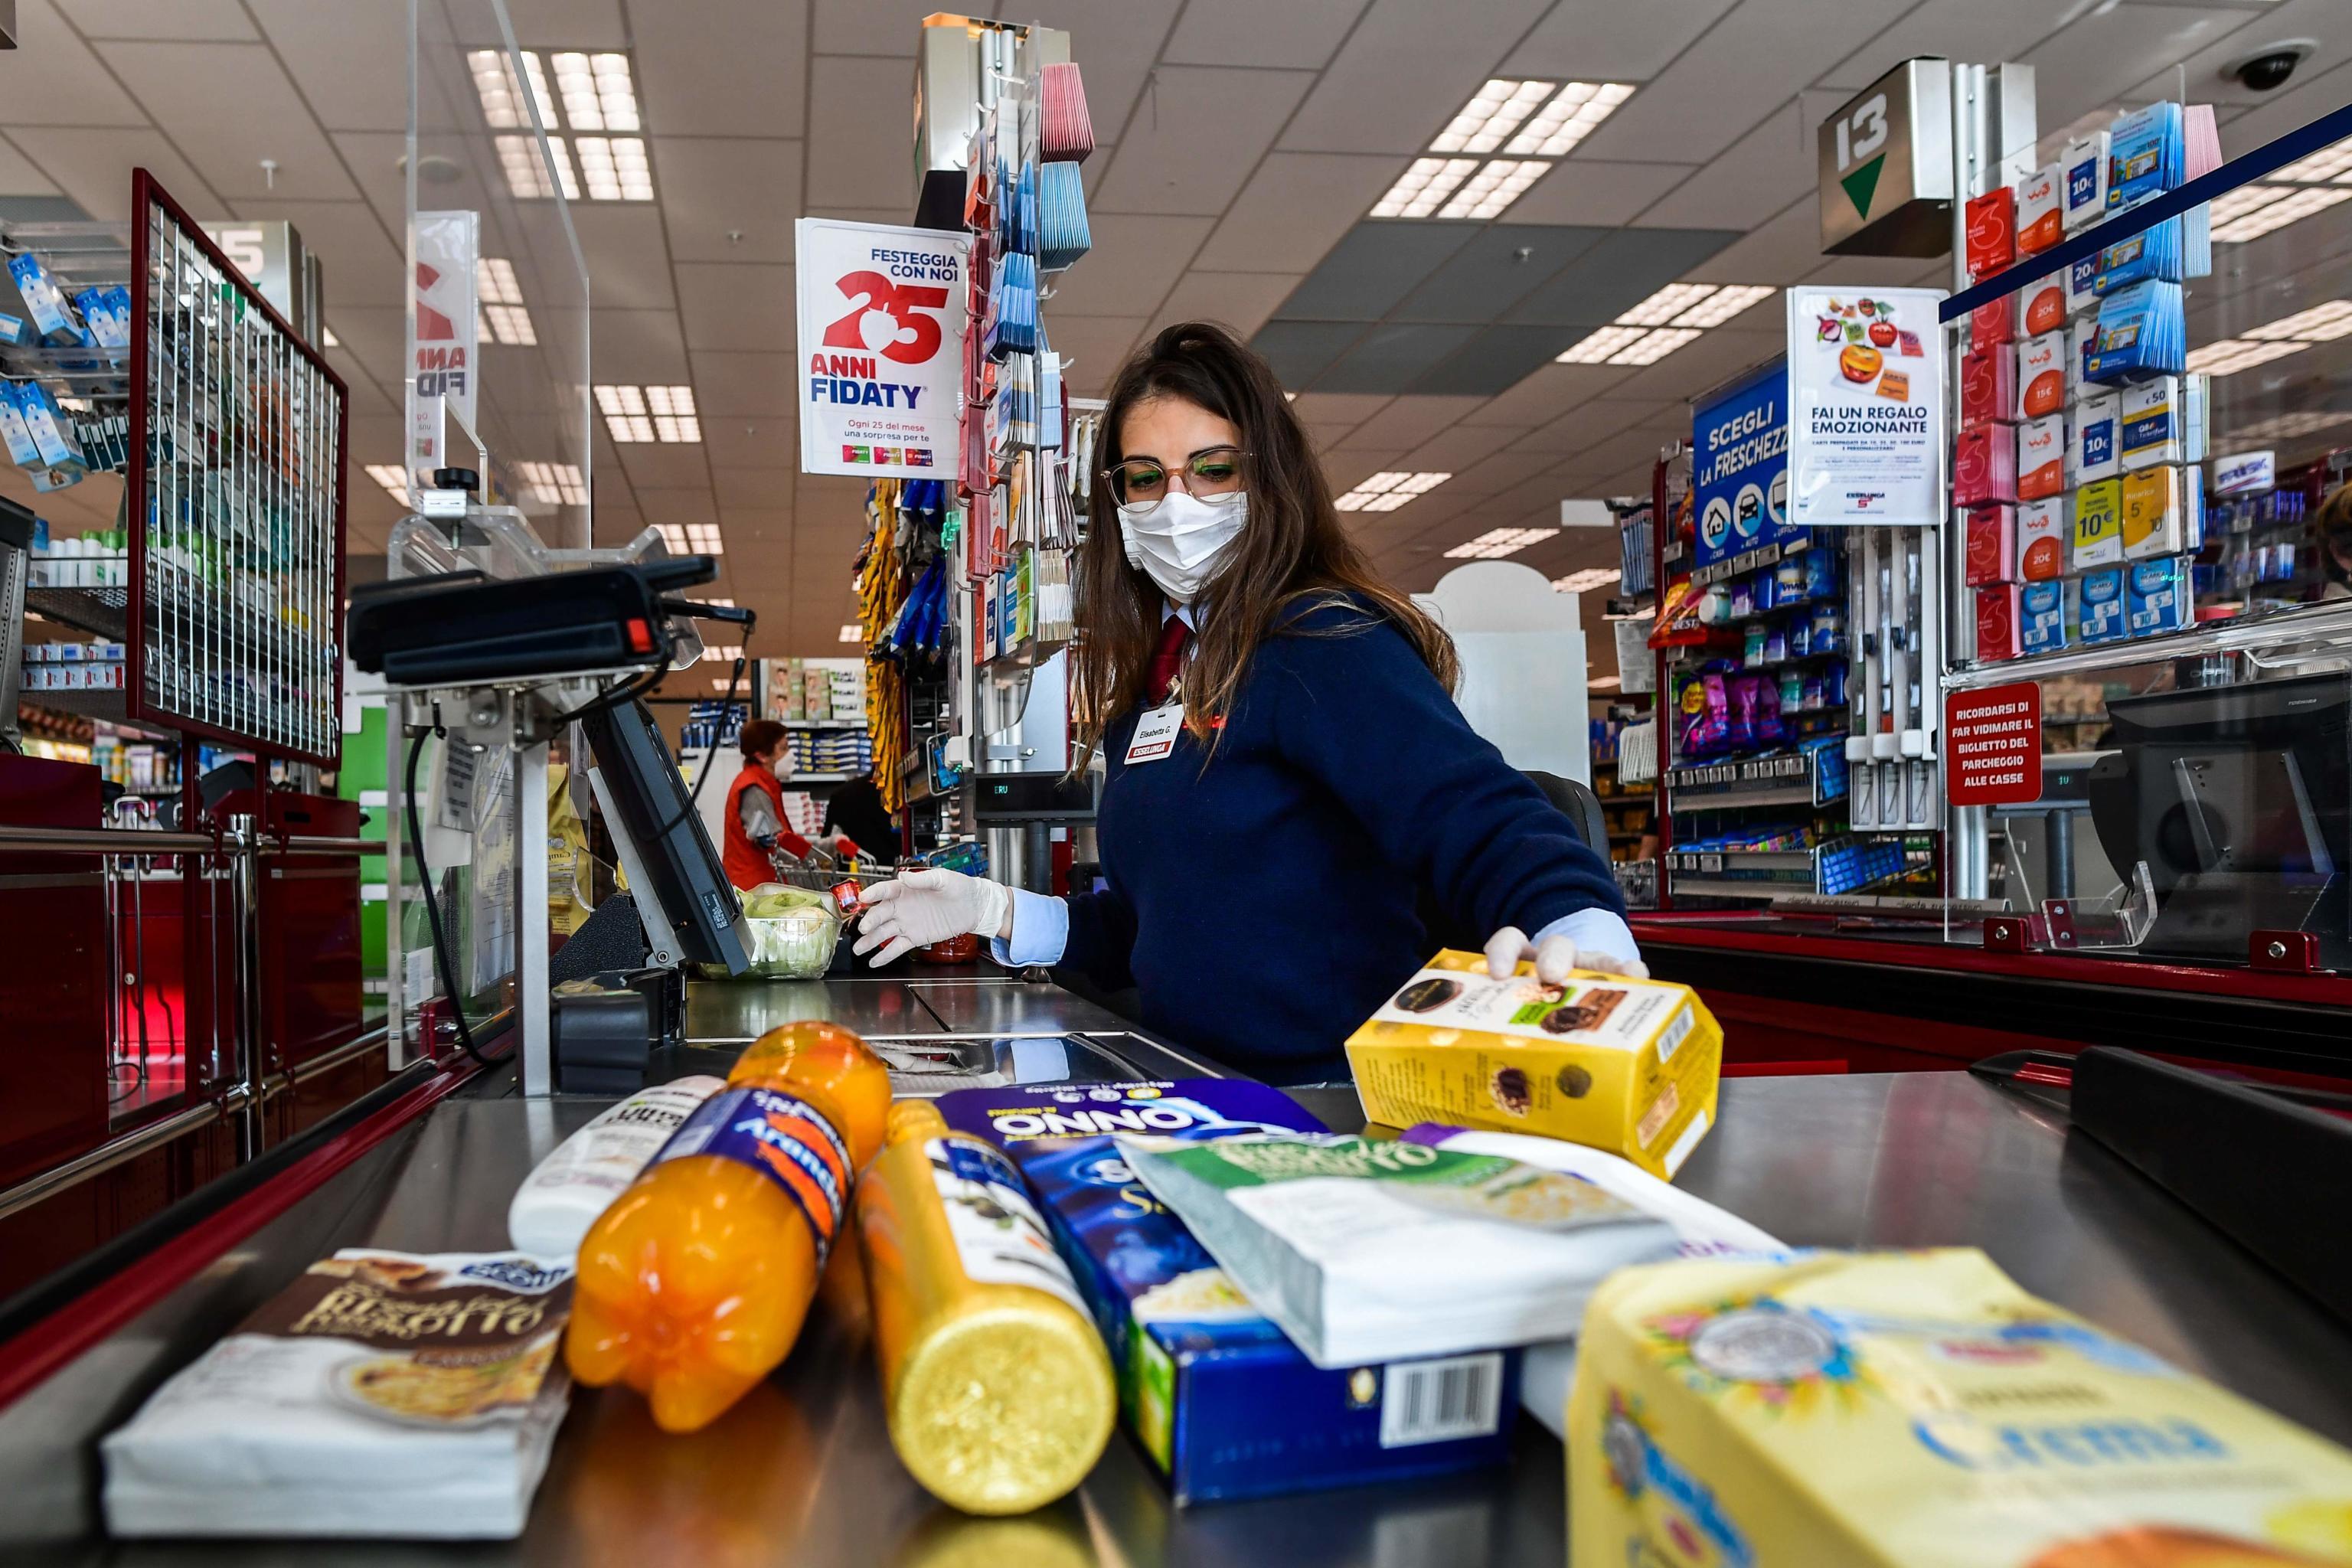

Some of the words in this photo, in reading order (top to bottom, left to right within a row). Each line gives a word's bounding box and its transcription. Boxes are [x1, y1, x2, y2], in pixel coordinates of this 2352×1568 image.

[1837, 93, 1888, 172] 13
[2072, 176, 2094, 196] 10€
[205, 230, 263, 275] 5
[871, 249, 957, 268] FESTEGGIA
[890, 265, 925, 279] CON
[929, 266, 958, 282] NOI
[822, 270, 949, 365] 25
[811, 353, 876, 379] ANNI
[2152, 390, 2166, 403] 50
[1811, 407, 1834, 420] FAI
[1839, 407, 1862, 420] UN
[1867, 406, 1927, 420] REGALO
[848, 420, 870, 430] Ogni
[872, 421, 884, 430] 25
[886, 422, 900, 431] del
[901, 424, 925, 433] mese
[1709, 400, 1774, 452] SCEGLI
[1811, 420, 1927, 434] EMOZIONANTE
[863, 432, 901, 443] sorpresa
[903, 434, 918, 443] per
[2087, 436, 2109, 454] 10€
[1700, 466, 1713, 487] LA
[1713, 424, 1789, 482] FRESCHEZZ
[1956, 703, 2015, 720] RICORDARSI
[2018, 701, 2029, 712] DI
[1952, 727, 1970, 738] FAR
[1973, 720, 2022, 736] VIDIMARE
[2024, 719, 2034, 729] IL
[1958, 739, 2007, 754] BIGLIETTO
[2010, 737, 2029, 749] DEL
[1962, 755, 2024, 770] PARCHEGGIO
[1965, 776, 1987, 787] ALLE
[1989, 773, 2024, 785] CASSE
